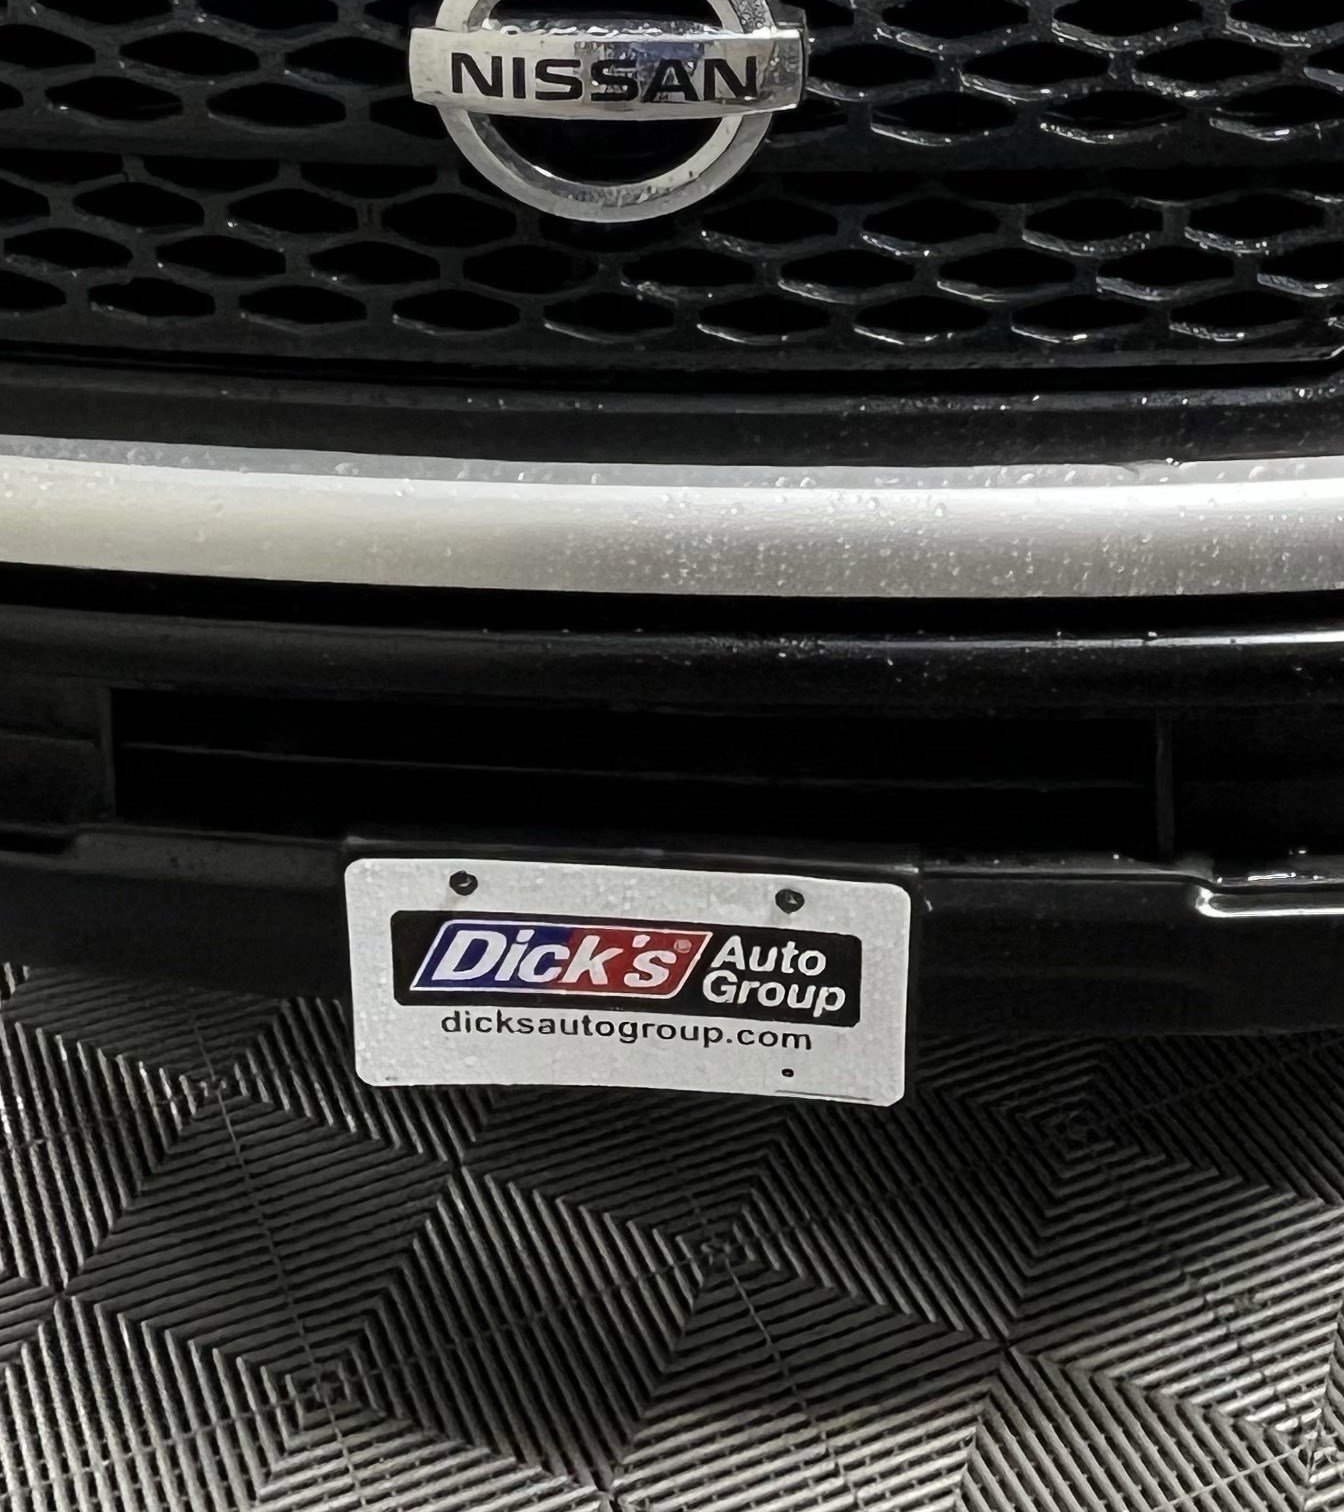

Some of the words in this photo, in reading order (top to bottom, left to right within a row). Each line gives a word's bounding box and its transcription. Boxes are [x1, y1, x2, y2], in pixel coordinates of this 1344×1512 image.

[451, 52, 757, 101] NISSAN
[431, 928, 676, 989] Dick's
[711, 935, 827, 976] Auto
[702, 969, 846, 1017] Group
[441, 1010, 813, 1050] dicksautogroup.com
